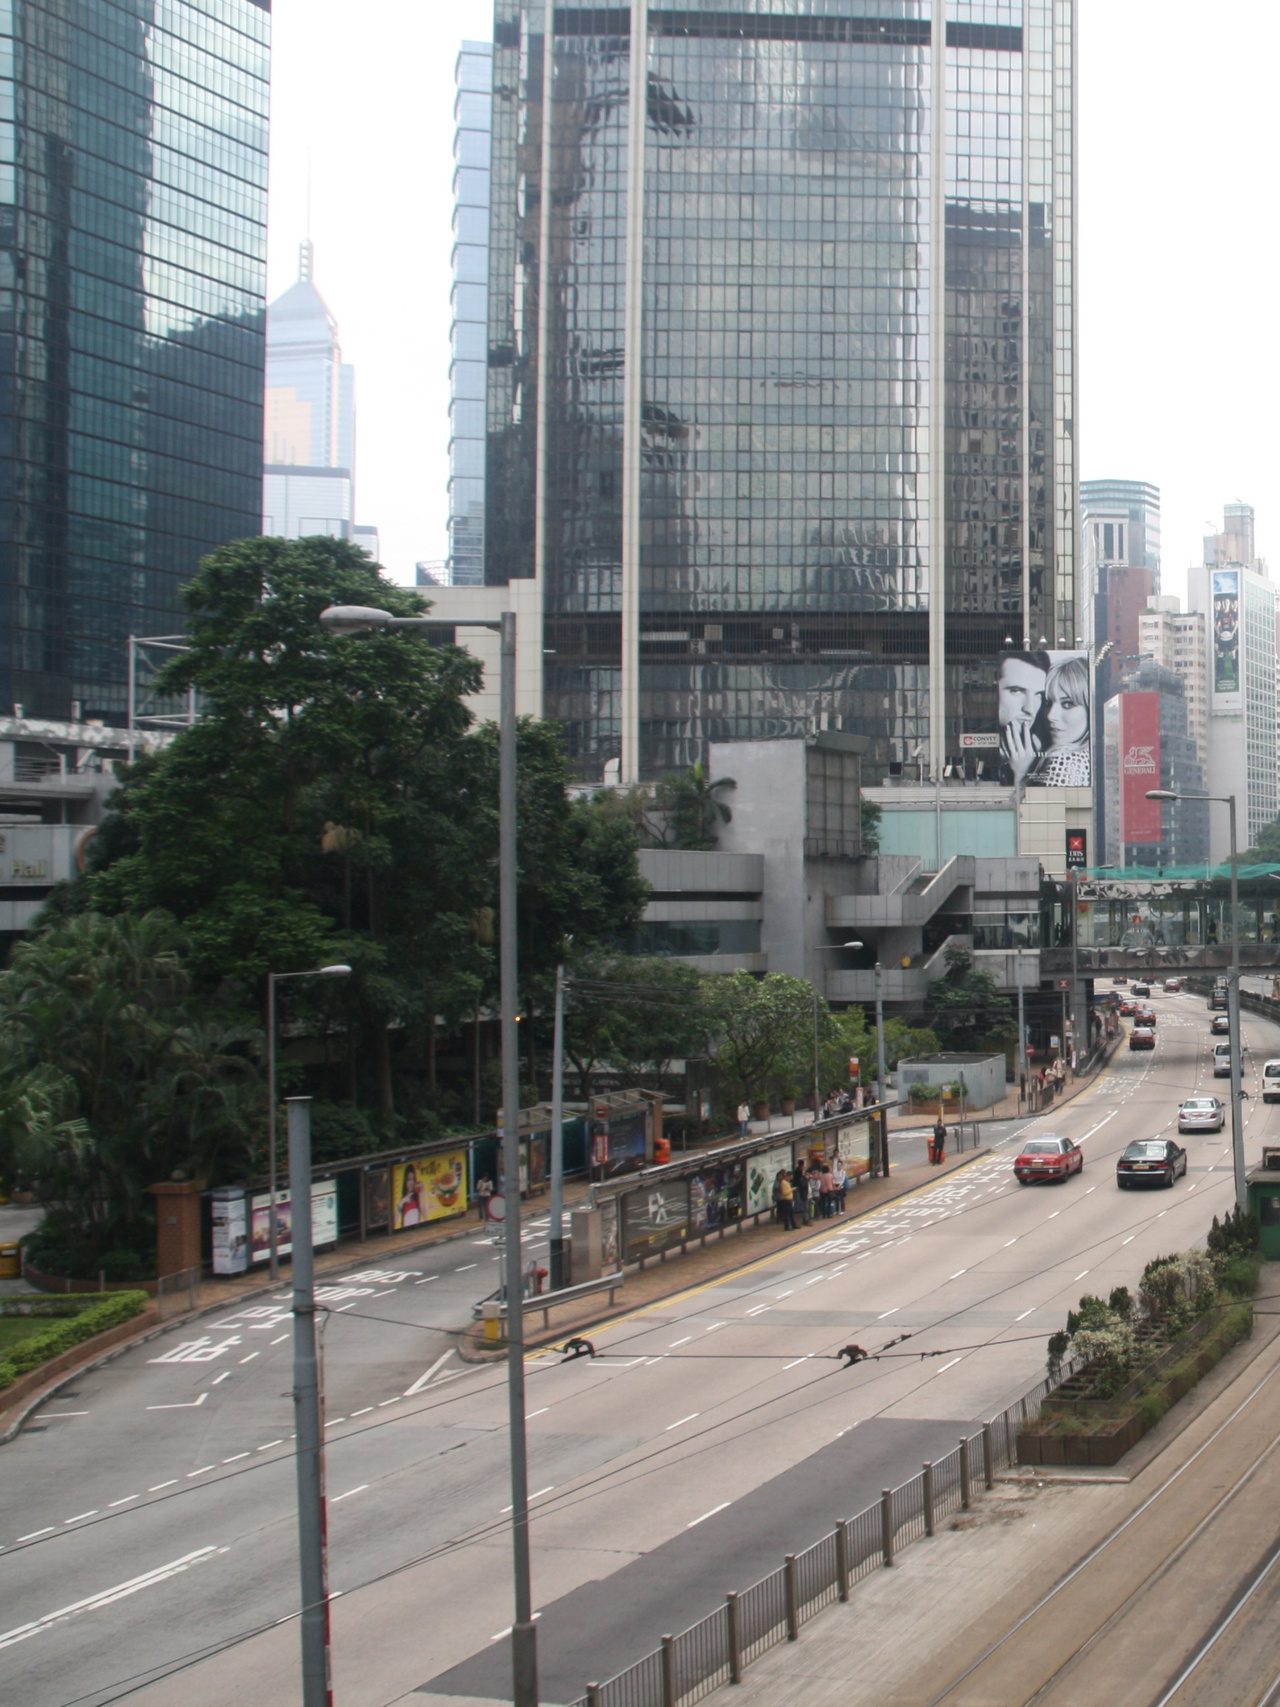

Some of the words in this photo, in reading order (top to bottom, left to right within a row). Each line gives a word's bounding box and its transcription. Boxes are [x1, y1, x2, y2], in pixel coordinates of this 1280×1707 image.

[11, 860, 46, 877] Hall
[901, 1197, 962, 1206] BUS
[871, 1207, 946, 1218] STOP
[336, 1270, 424, 1284] BUS
